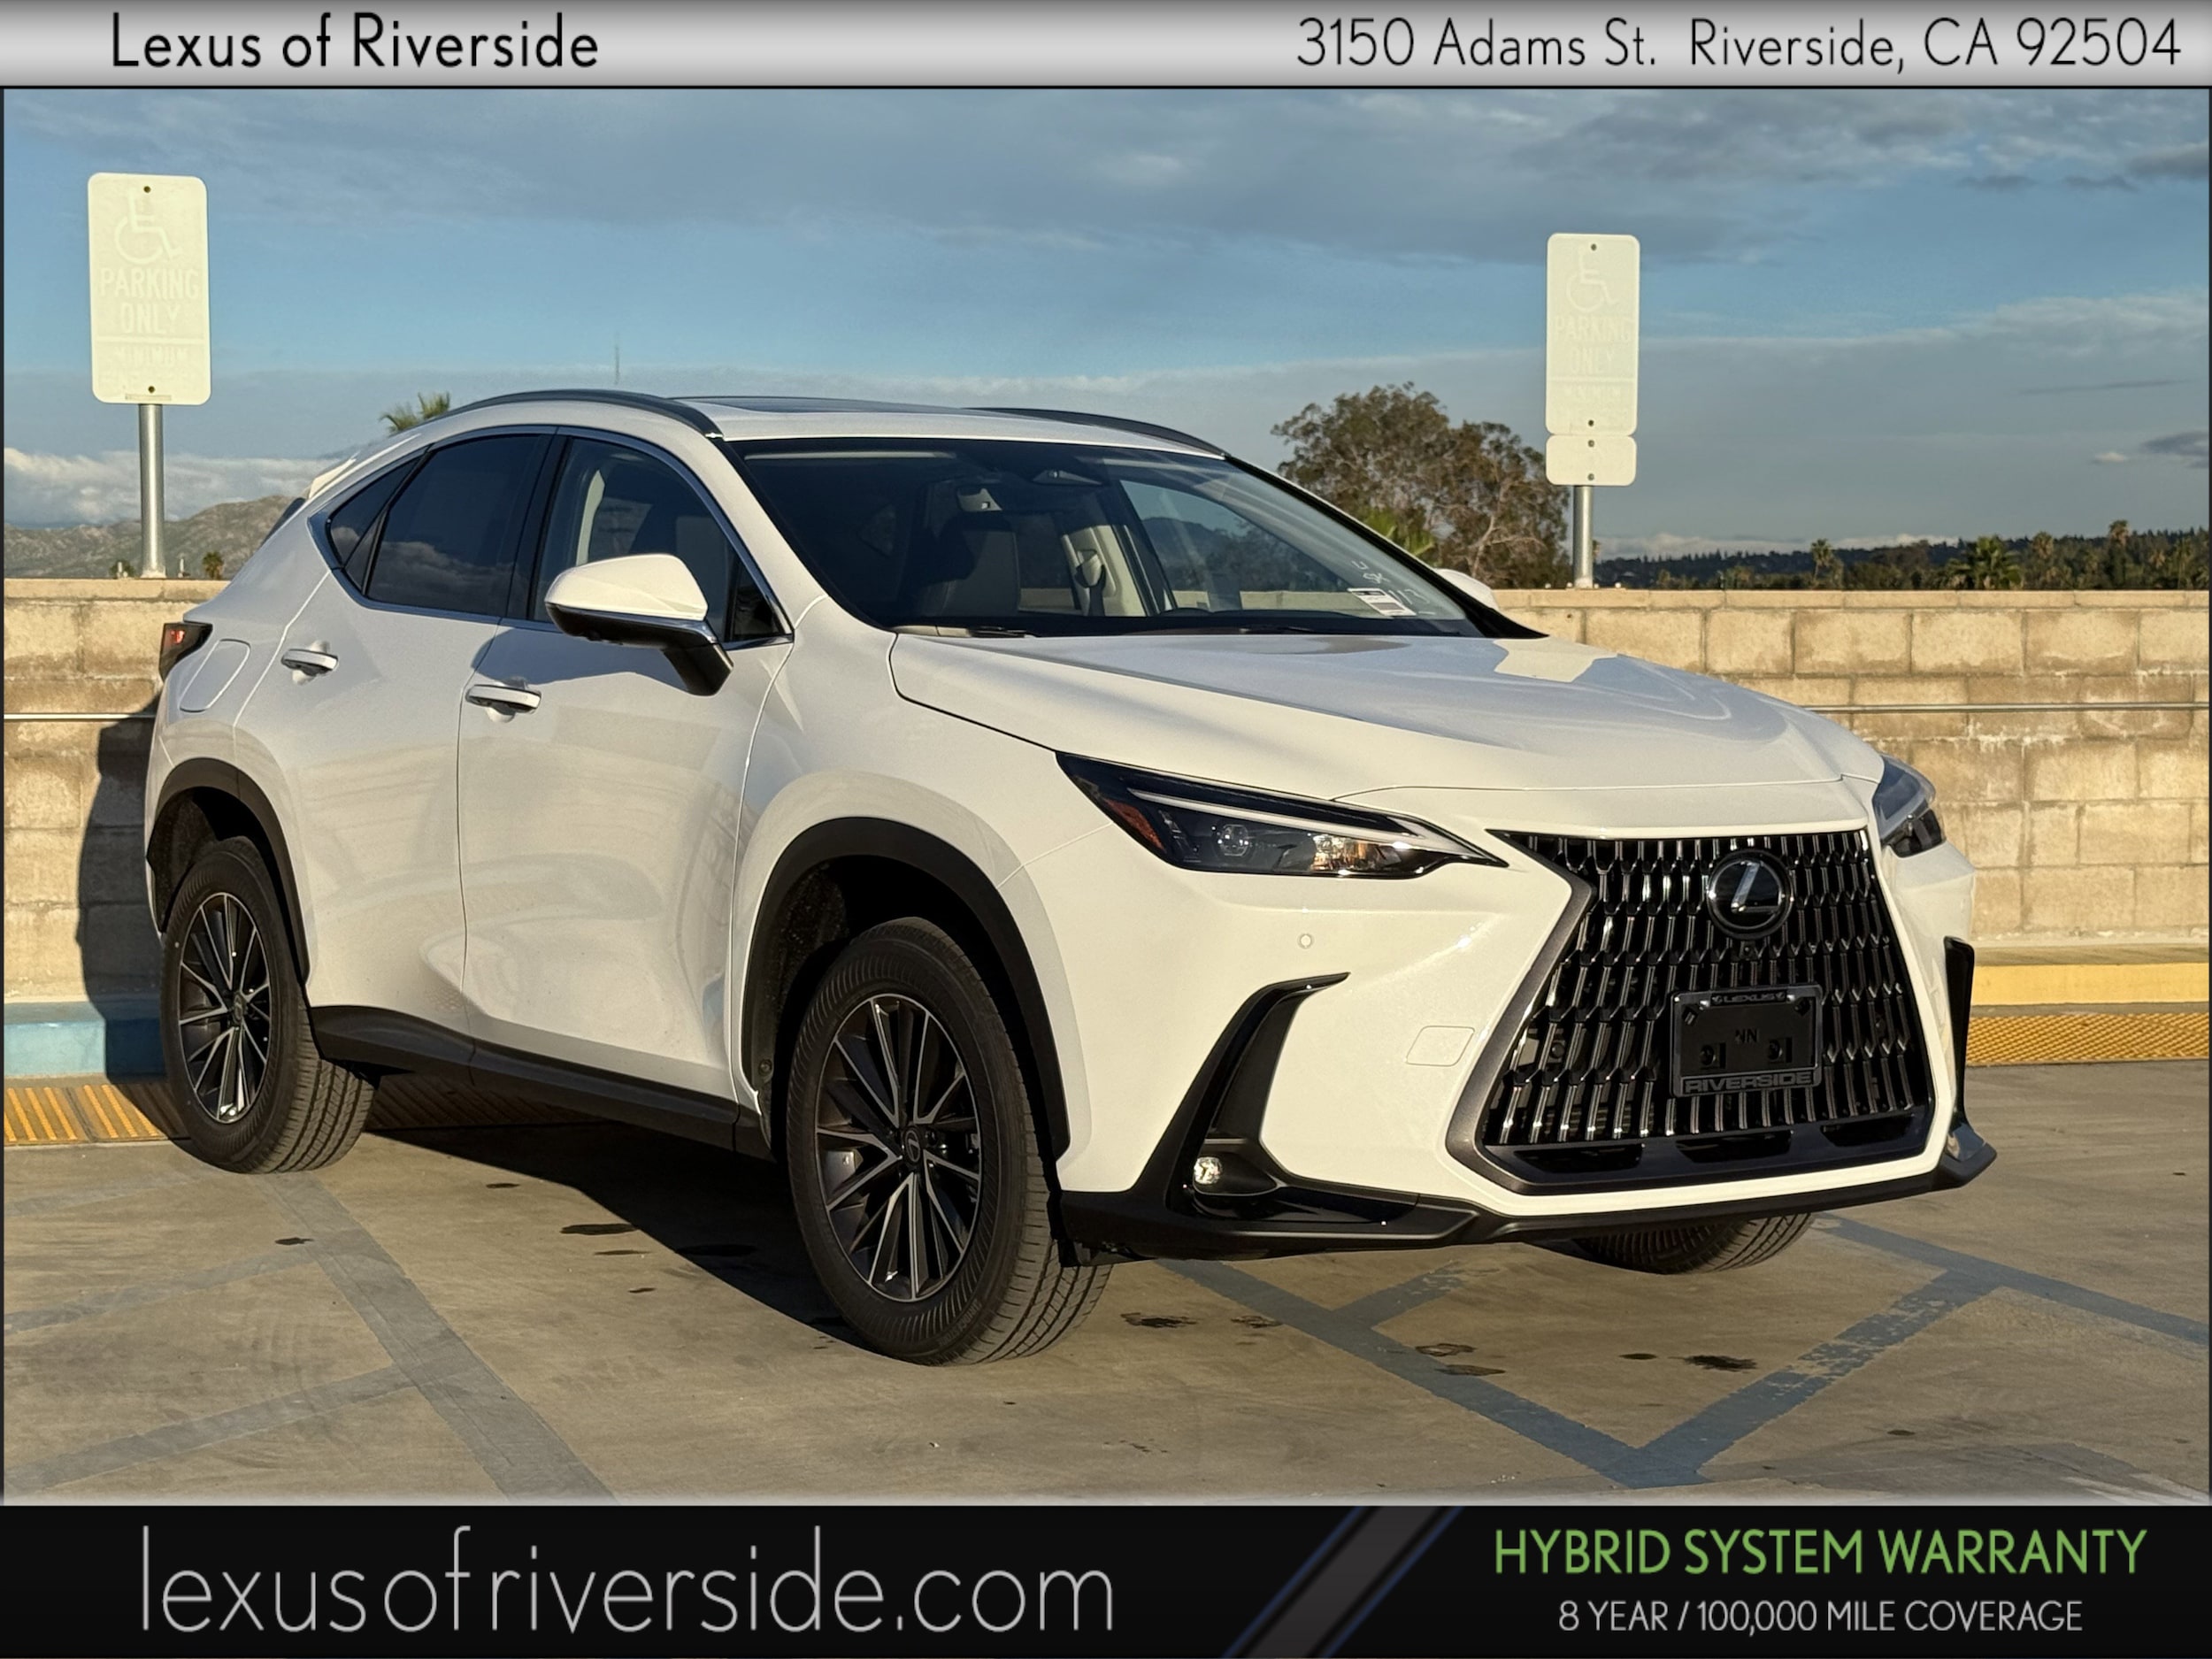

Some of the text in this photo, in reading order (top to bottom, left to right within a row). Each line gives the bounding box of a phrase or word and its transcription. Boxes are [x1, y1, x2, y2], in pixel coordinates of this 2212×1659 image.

[99, 267, 199, 299] PARKING
[120, 302, 181, 334] ONLY
[1555, 314, 1632, 342] PARKING
[1724, 994, 1775, 1002] LEXUS
[1684, 1071, 1813, 1094] RIVERSIDE
